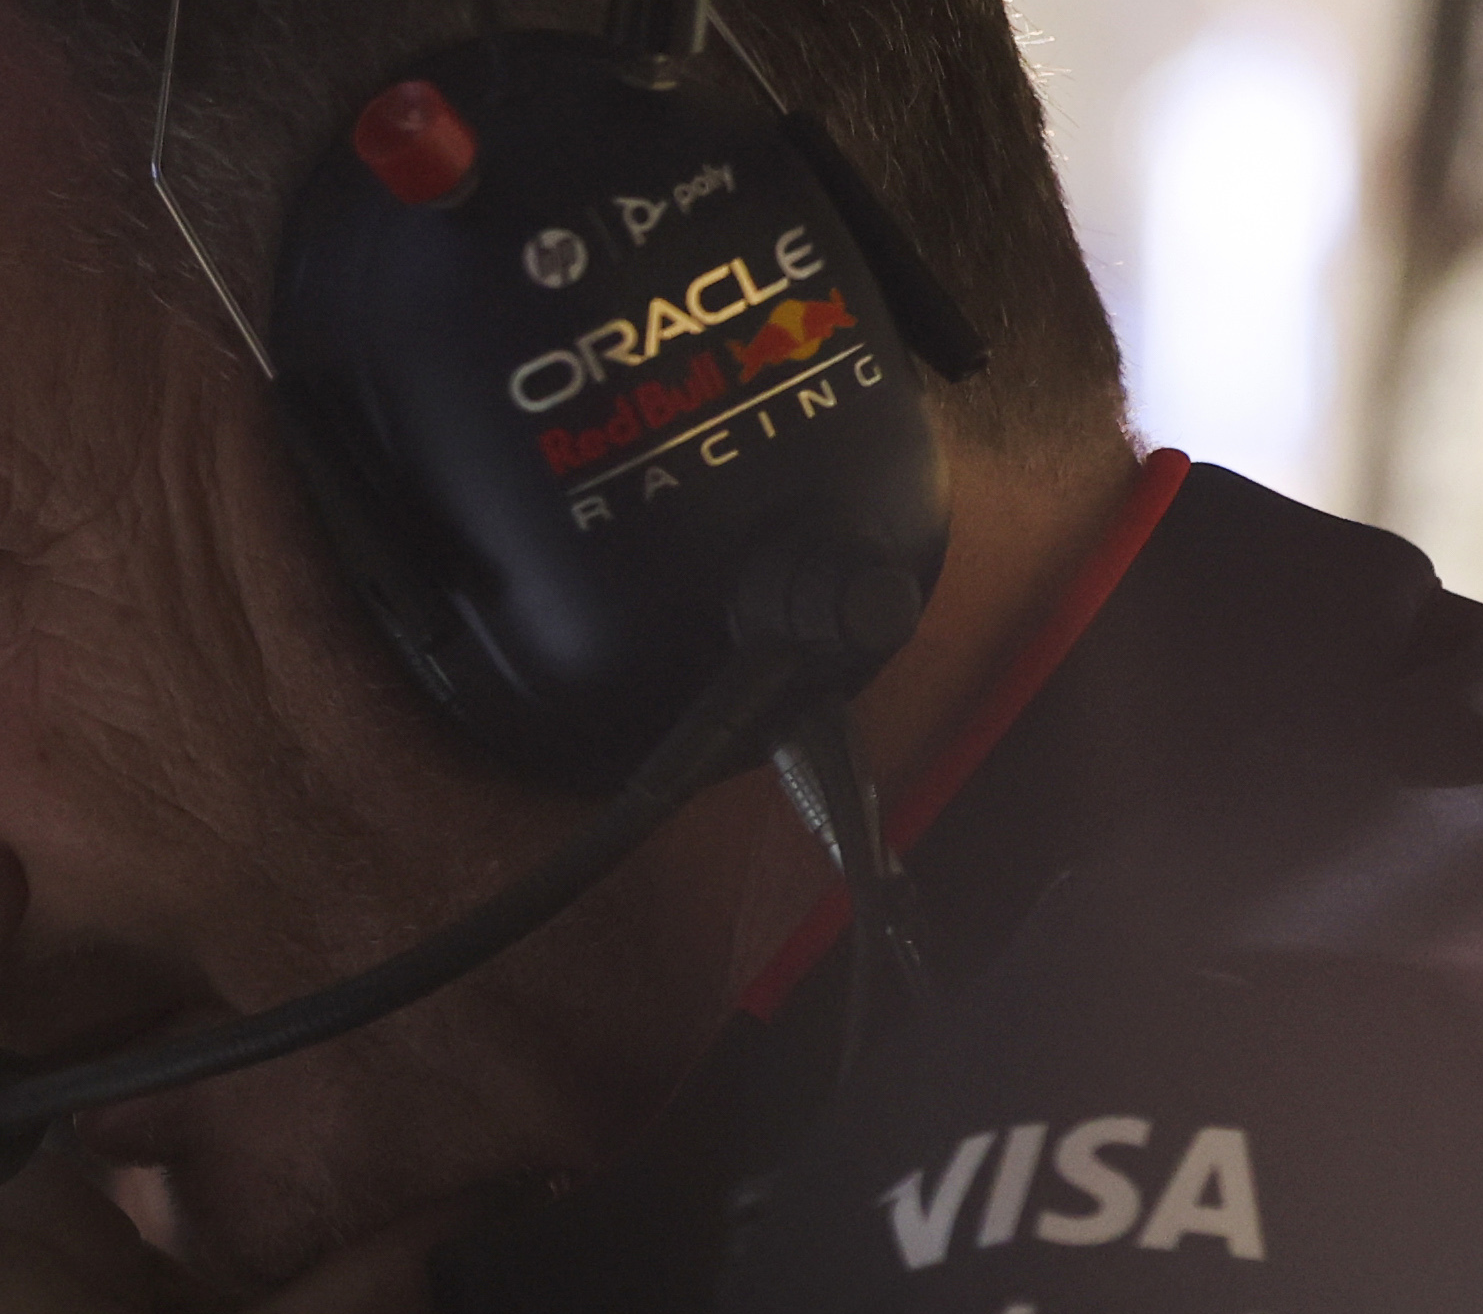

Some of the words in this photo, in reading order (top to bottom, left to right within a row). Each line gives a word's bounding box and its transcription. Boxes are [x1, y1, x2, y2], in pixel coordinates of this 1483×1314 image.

[509, 225, 826, 413] ORACLE
[539, 396, 643, 475] Red
[635, 351, 729, 430] Bull
[570, 353, 884, 532] RACING
[878, 1115, 1265, 1271] VISA
